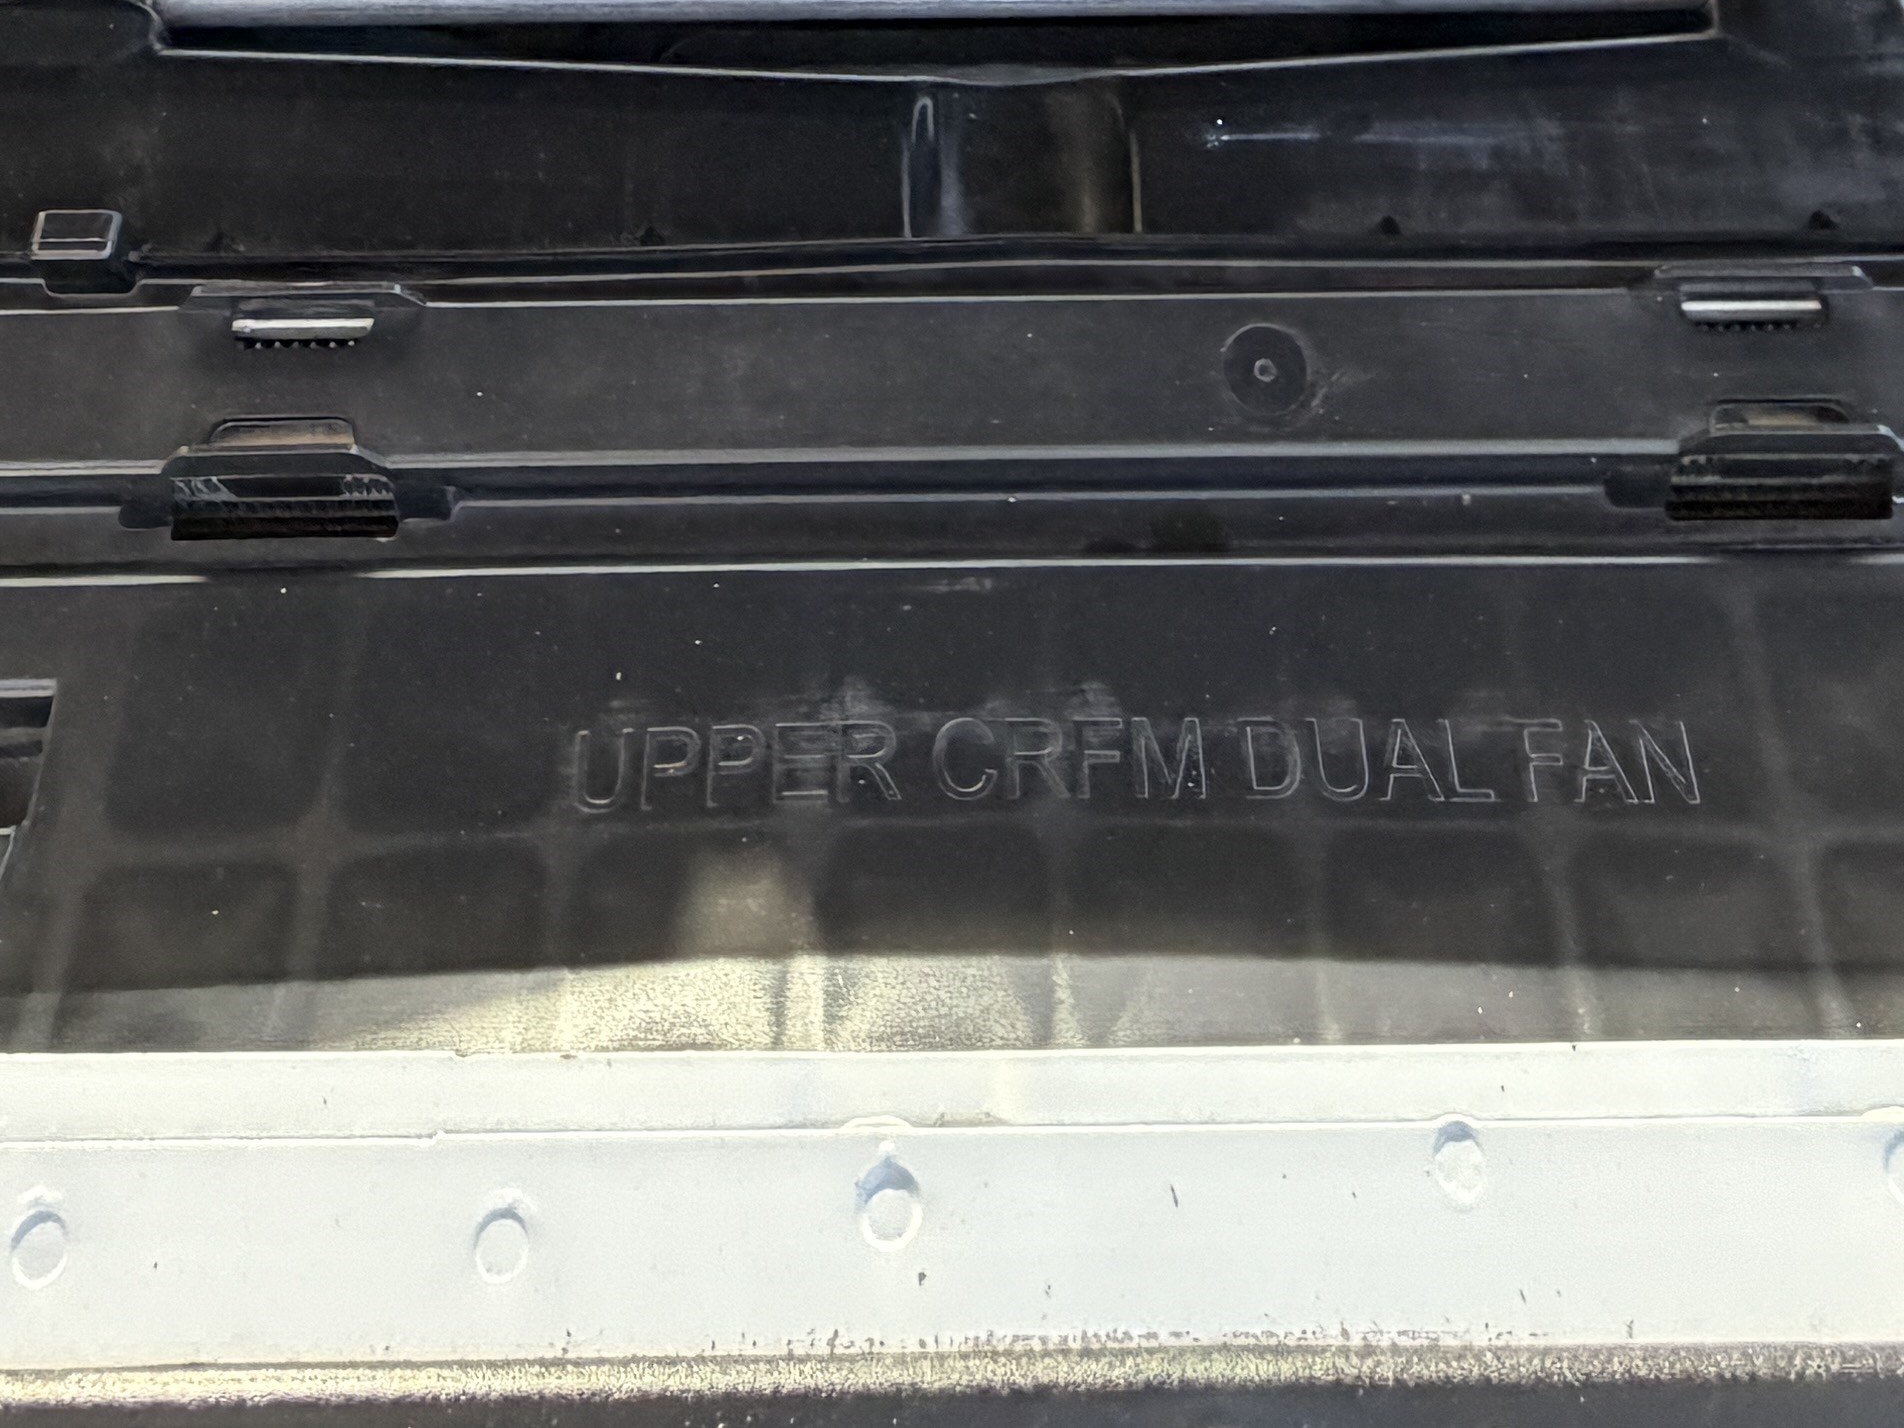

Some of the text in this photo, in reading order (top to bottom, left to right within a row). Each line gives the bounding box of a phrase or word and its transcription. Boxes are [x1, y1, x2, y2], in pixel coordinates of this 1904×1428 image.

[572, 715, 1701, 814] UPPER CRFM DUAL FAN
